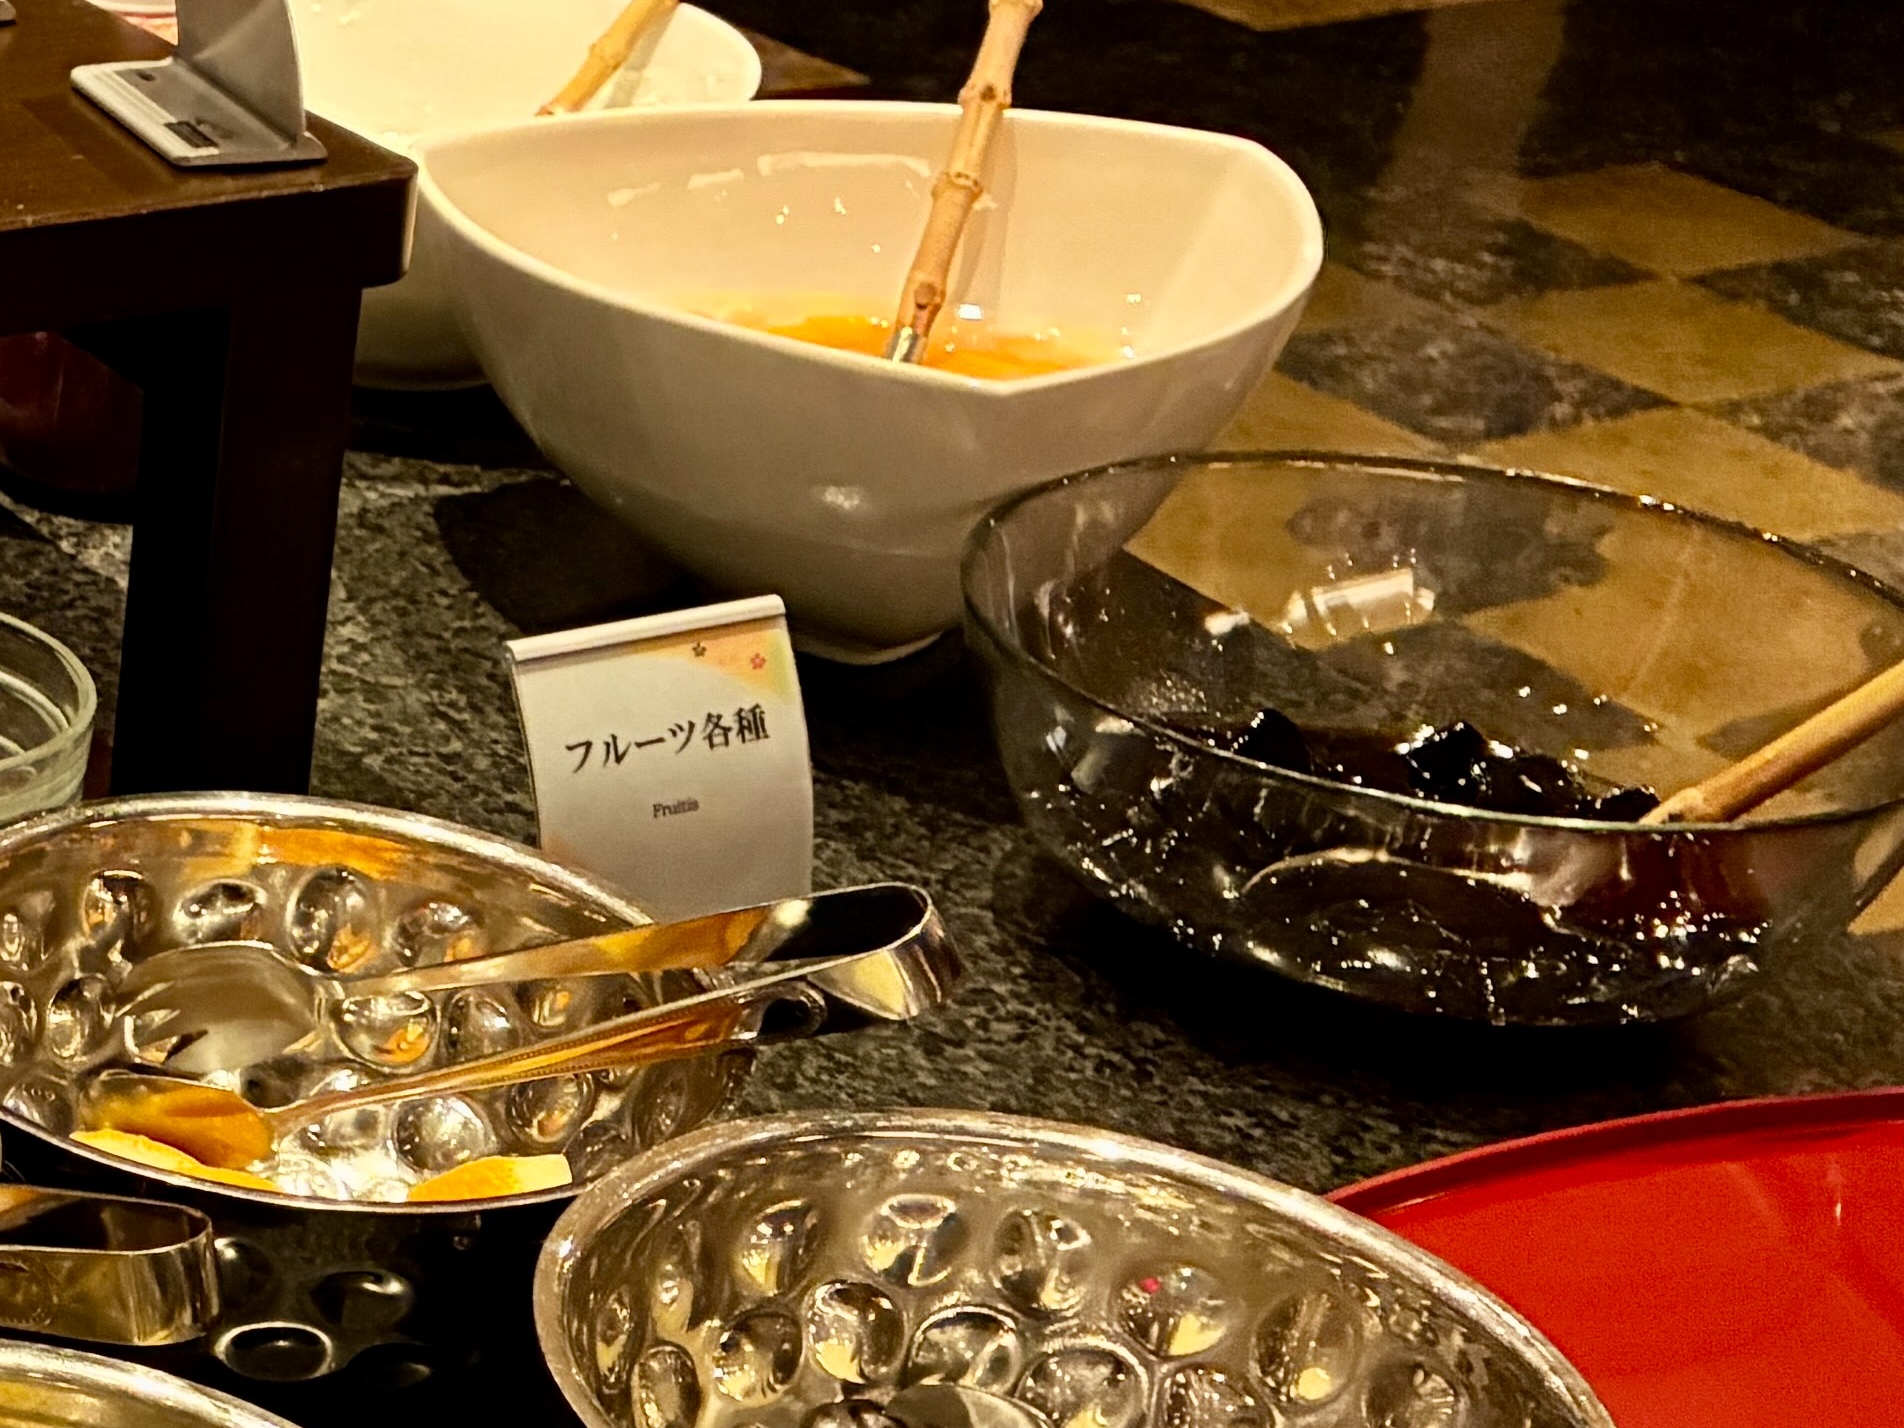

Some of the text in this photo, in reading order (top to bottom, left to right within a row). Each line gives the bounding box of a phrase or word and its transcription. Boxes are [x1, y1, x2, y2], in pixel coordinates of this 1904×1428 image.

[565, 703, 771, 774] フルーツ各種
